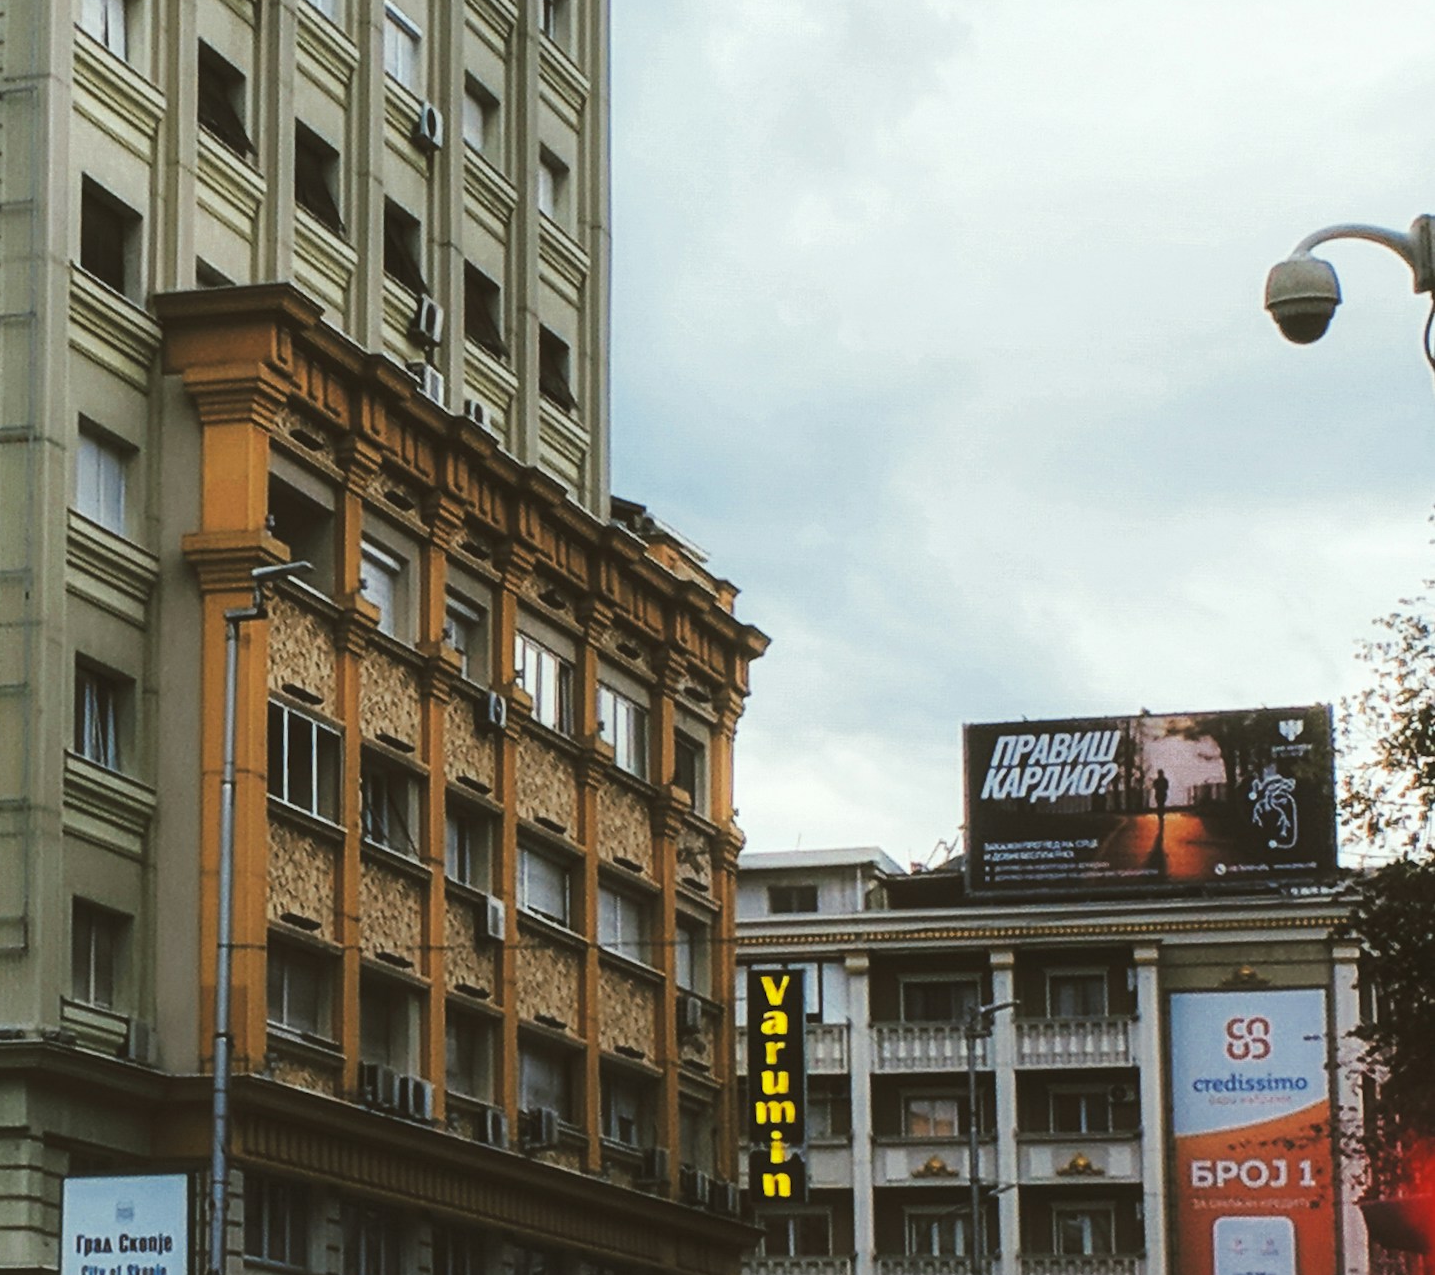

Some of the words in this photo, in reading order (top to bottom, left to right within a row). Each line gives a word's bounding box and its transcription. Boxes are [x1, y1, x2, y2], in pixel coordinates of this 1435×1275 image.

[990, 729, 1121, 767] ПРАВИШ
[980, 762, 1119, 804] КАРДИО?
[755, 975, 796, 1198] Varumin
[1193, 1073, 1308, 1092] credissimo
[1191, 1158, 1287, 1188] БРОЈ
[1299, 1159, 1316, 1187] 1
[76, 1234, 113, 1257] Град
[119, 1233, 172, 1255] Скопје
